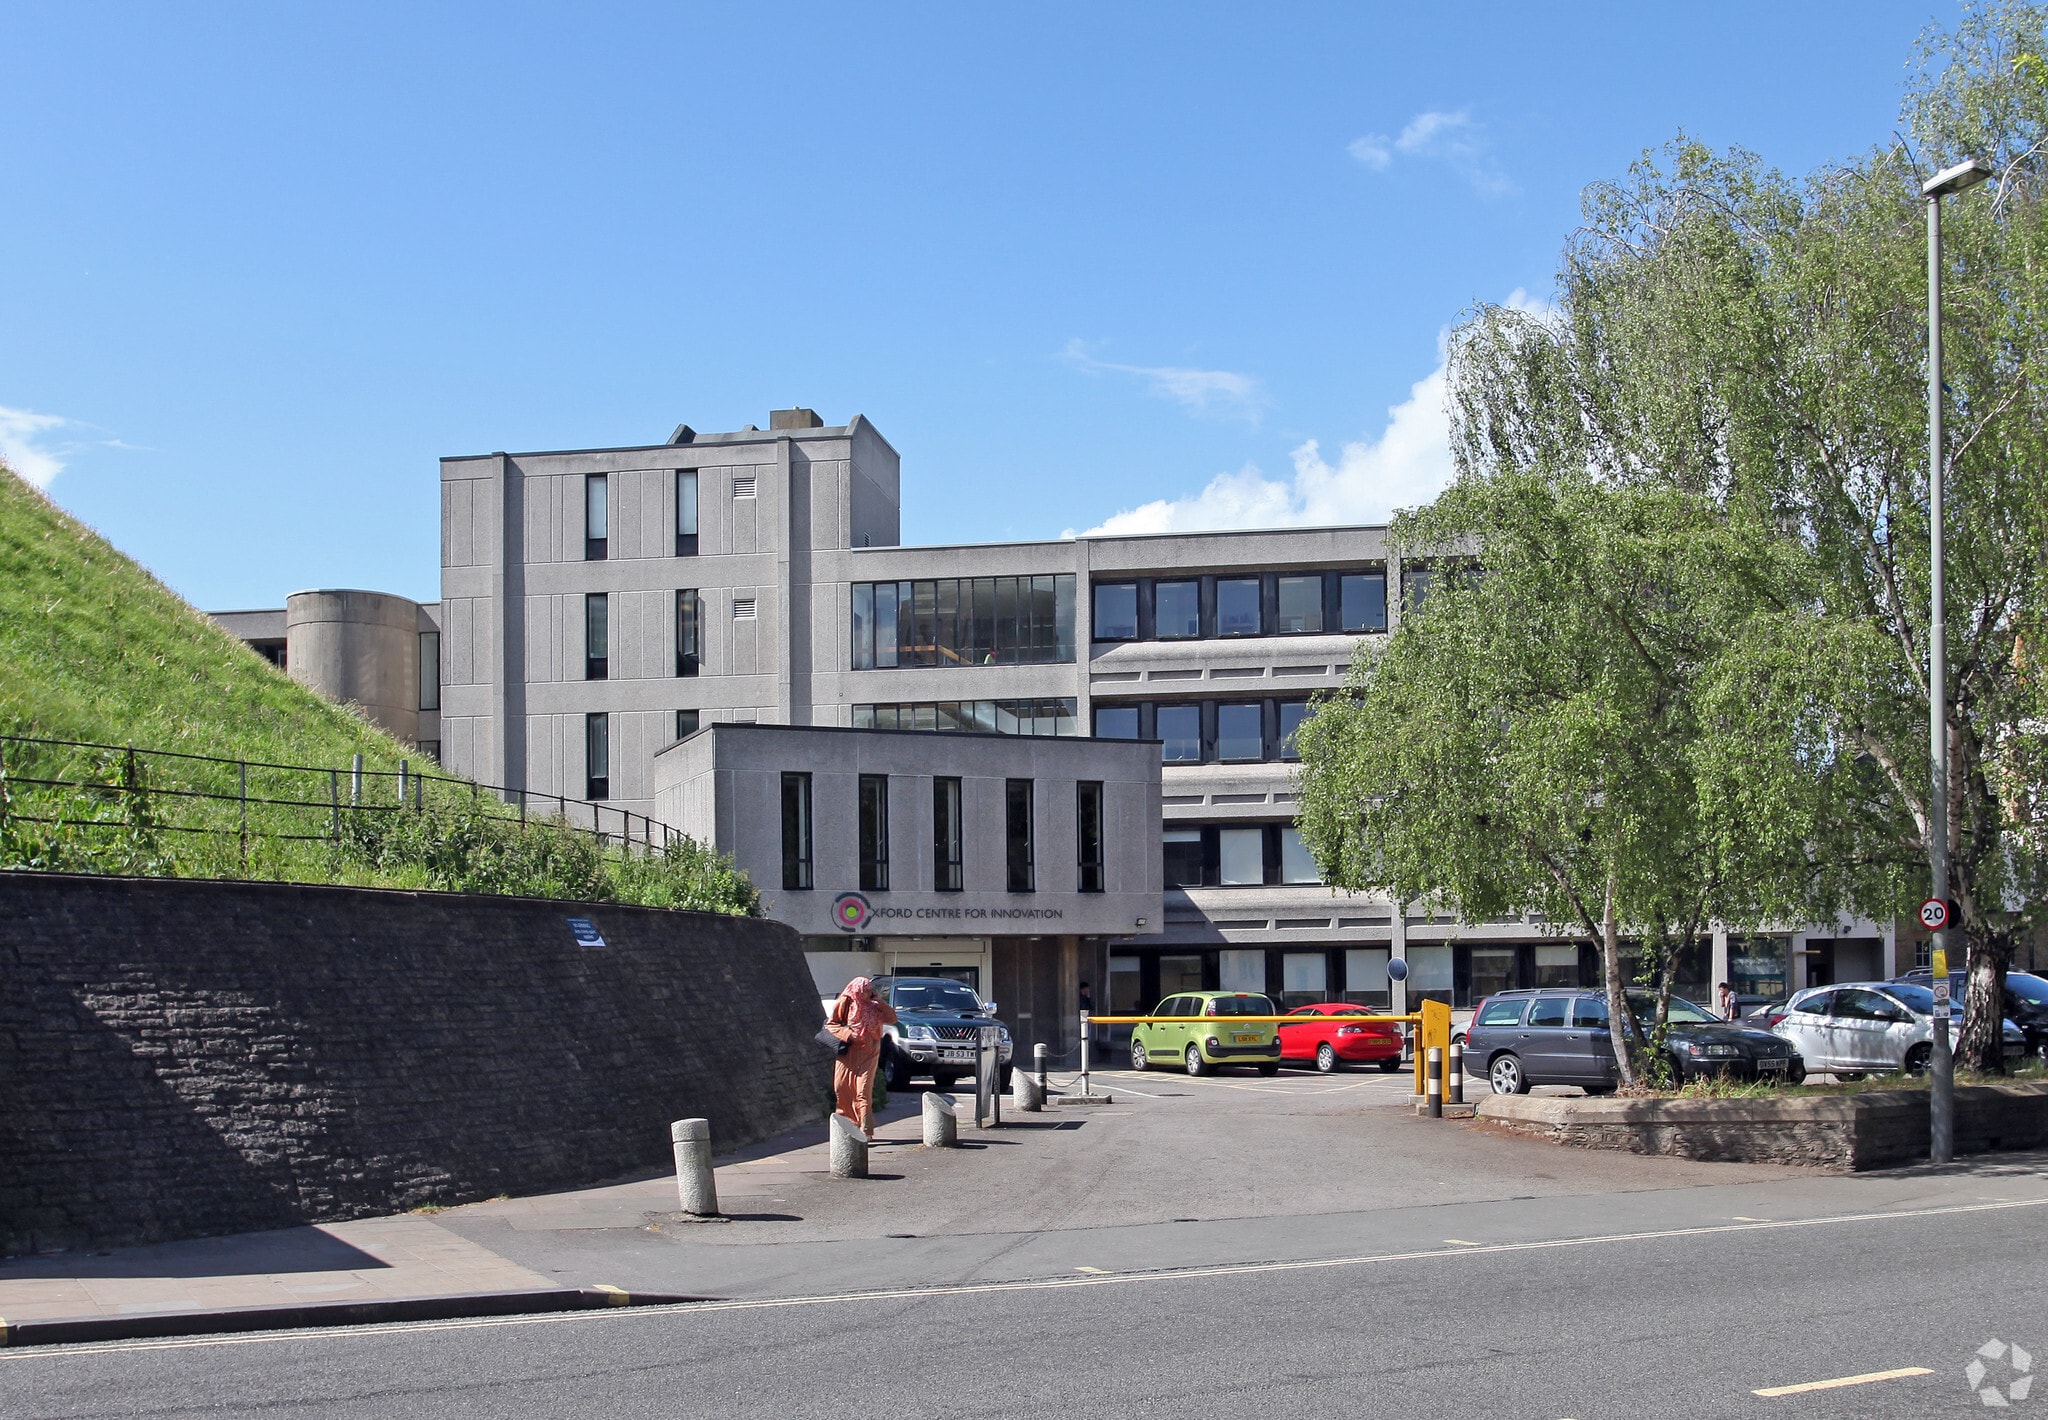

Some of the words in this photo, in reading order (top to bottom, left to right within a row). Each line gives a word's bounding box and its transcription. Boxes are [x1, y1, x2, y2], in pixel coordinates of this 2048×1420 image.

[916, 908, 960, 919] CENTRE
[965, 908, 987, 919] FOR
[991, 908, 1062, 919] INNOVATION
[1923, 907, 1944, 920] 20
